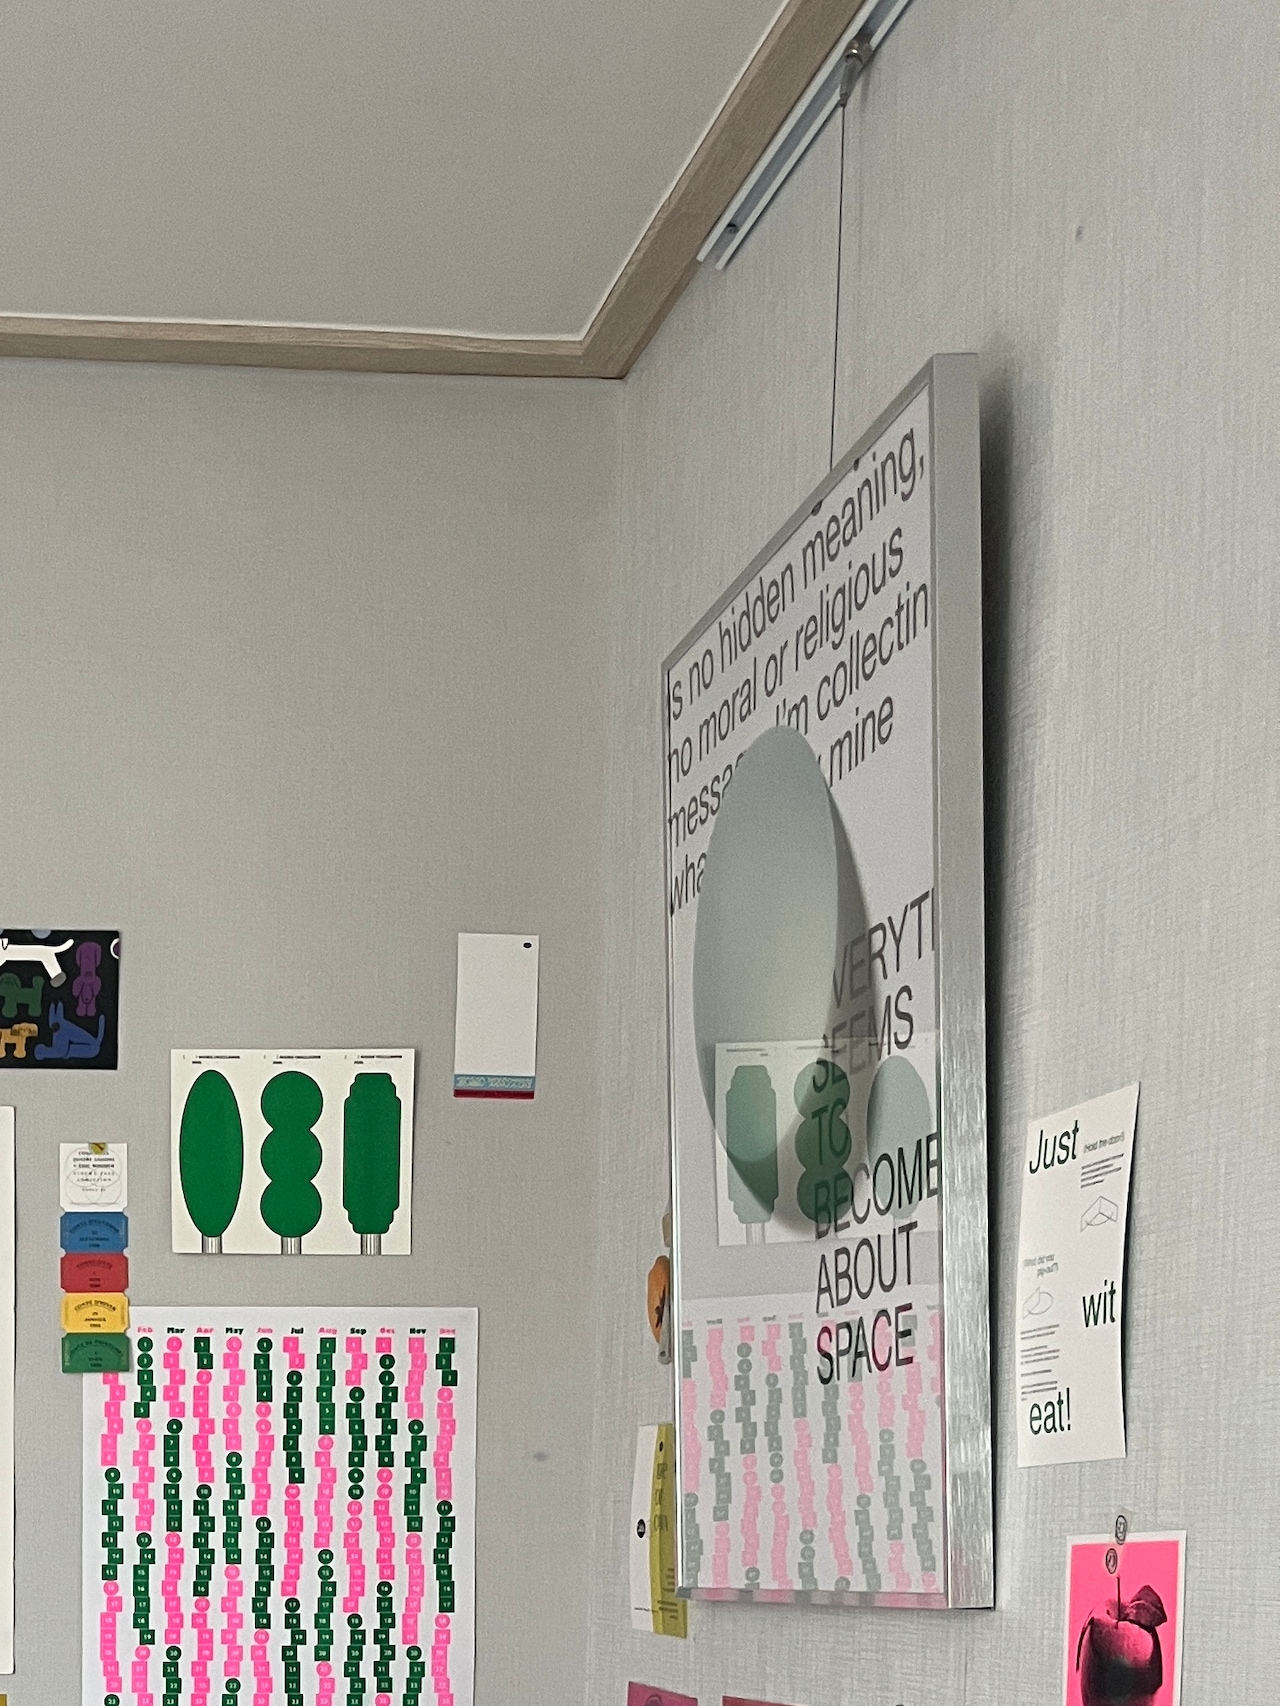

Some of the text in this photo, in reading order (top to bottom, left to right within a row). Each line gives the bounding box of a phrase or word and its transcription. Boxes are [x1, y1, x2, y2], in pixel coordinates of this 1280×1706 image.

[689, 649, 714, 705] no
[718, 563, 795, 673] hidden
[802, 428, 924, 590] meaning,
[668, 527, 903, 783] no moral or religious
[817, 582, 928, 721] collectin
[830, 696, 894, 788] mine
[812, 985, 914, 1093] SEEMS
[811, 1097, 849, 1165] TO
[1029, 1120, 1080, 1175] Just
[814, 1132, 939, 1239] BECOME
[815, 1221, 918, 1314] ABOUT
[1082, 1279, 1116, 1328] wit
[226, 1327, 244, 1335] May
[350, 1327, 367, 1335] Sep
[817, 1303, 914, 1385] SPACE
[1029, 1387, 1071, 1436] eat!
